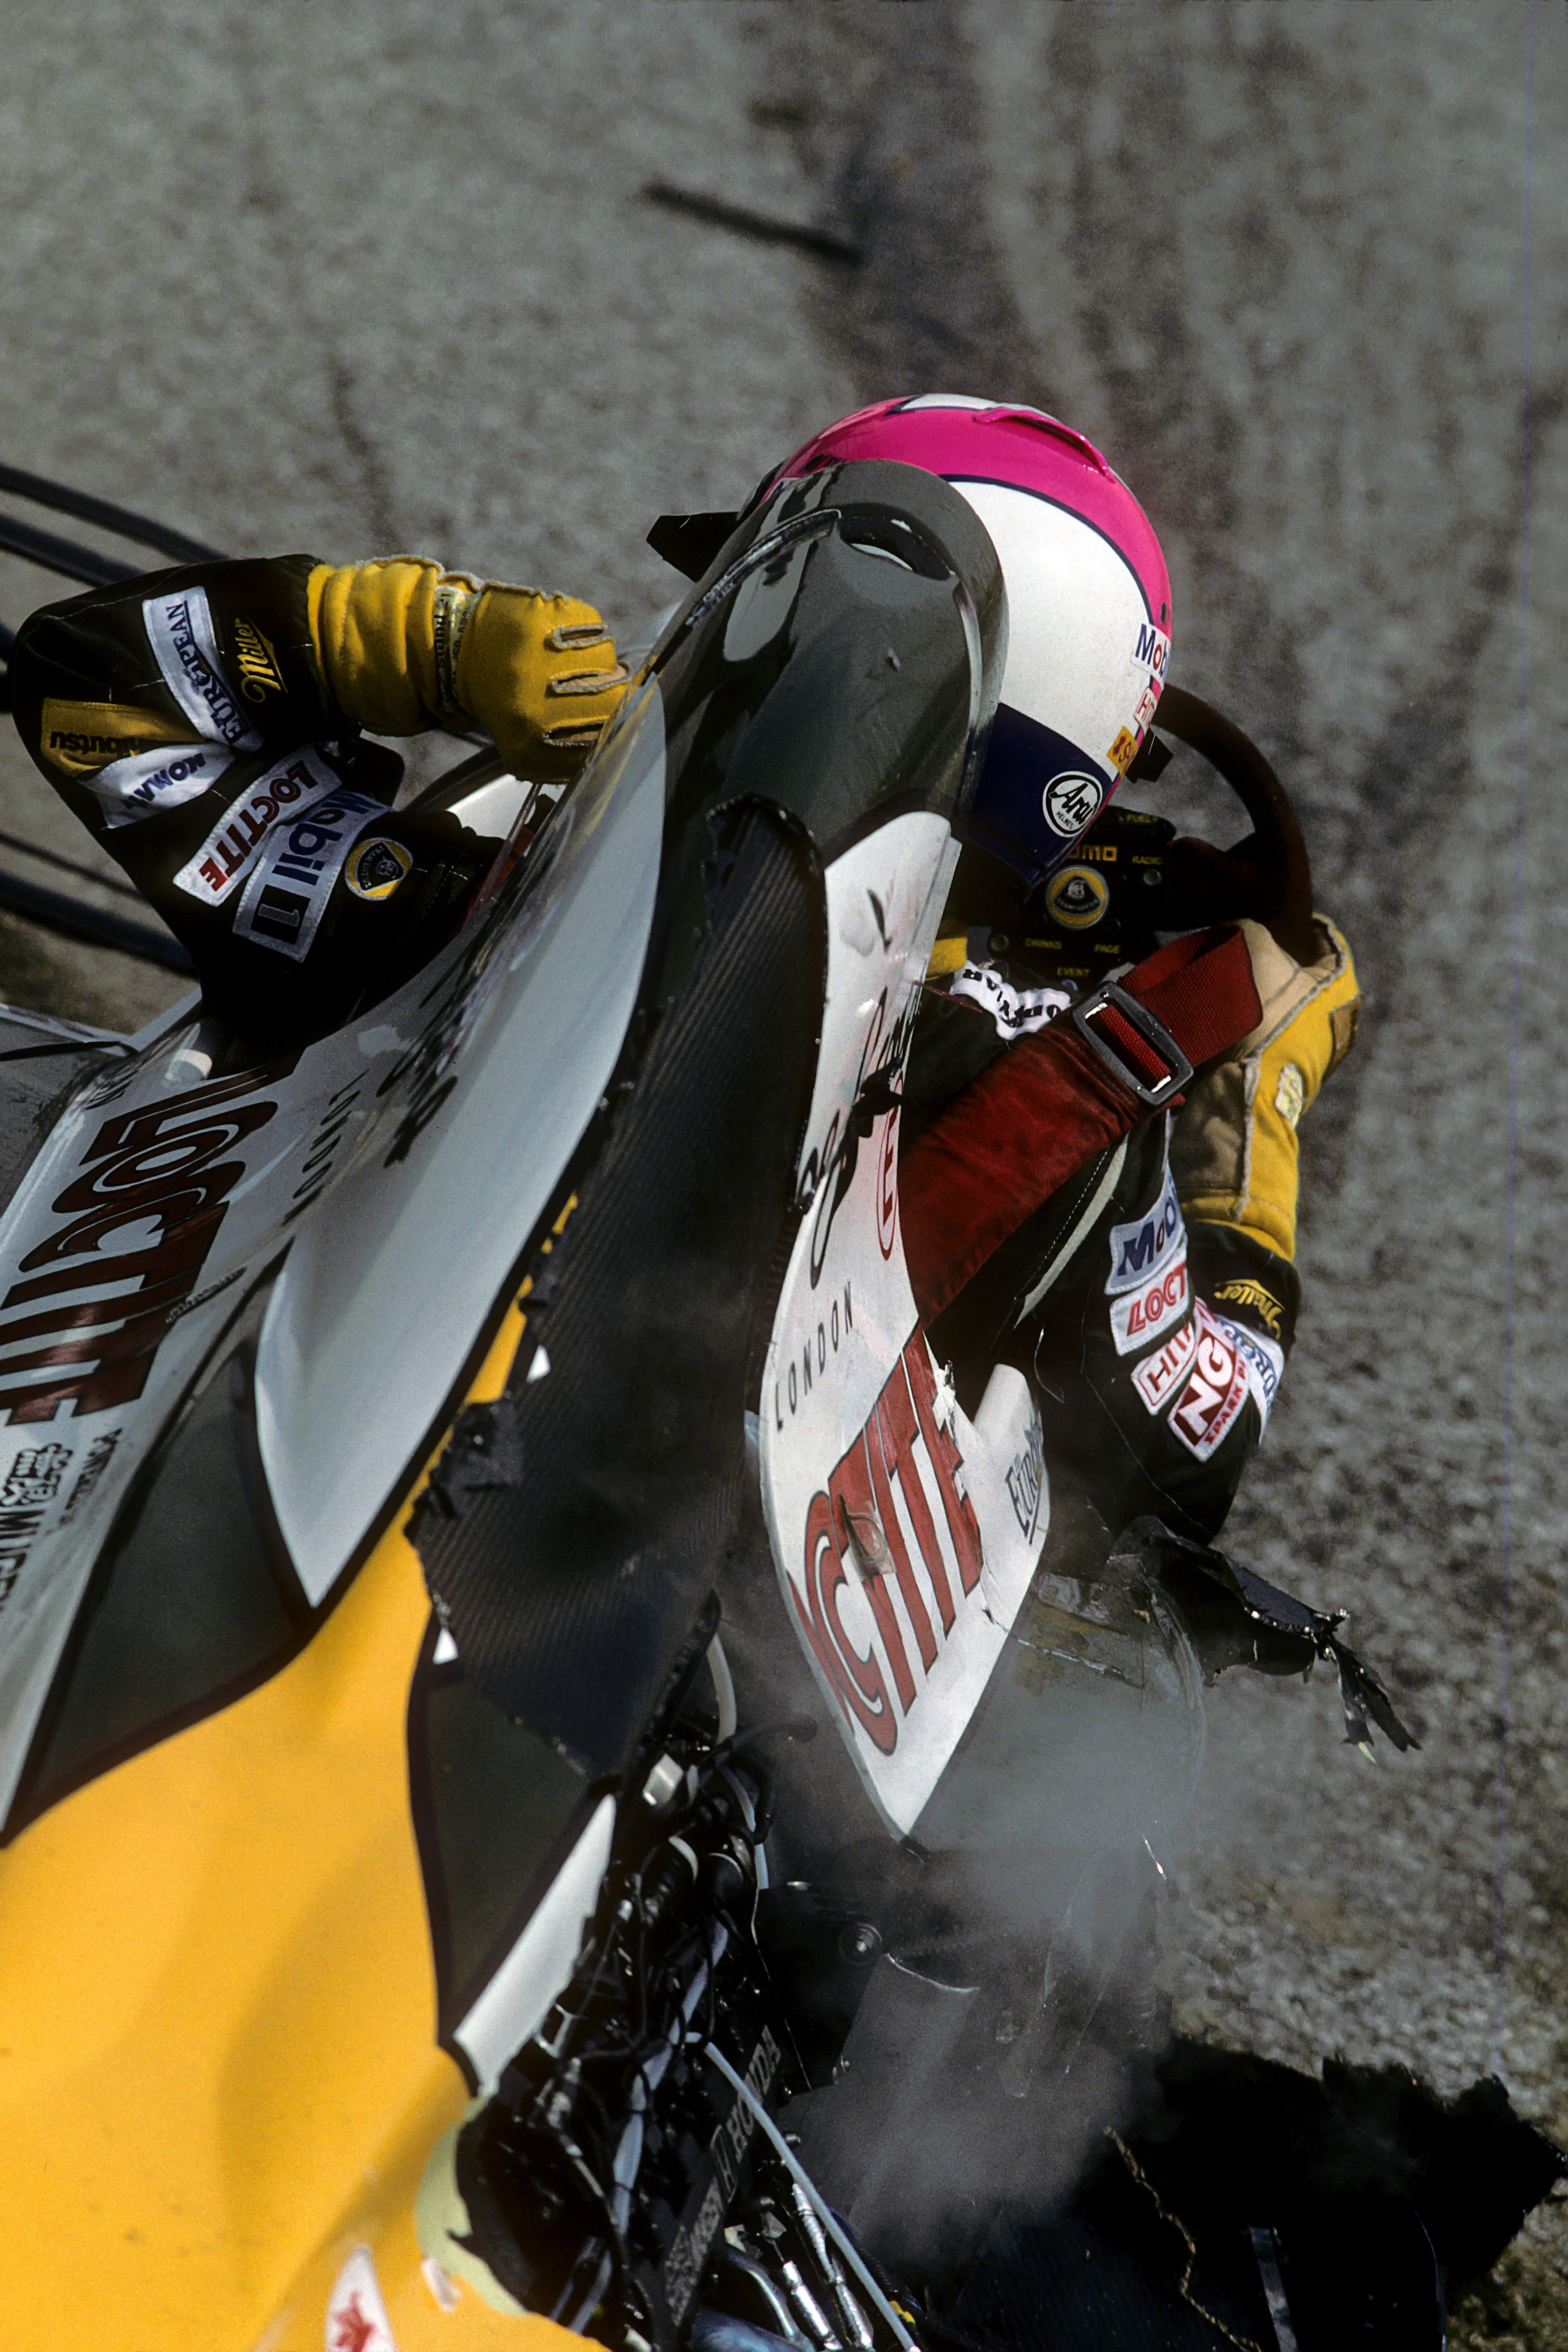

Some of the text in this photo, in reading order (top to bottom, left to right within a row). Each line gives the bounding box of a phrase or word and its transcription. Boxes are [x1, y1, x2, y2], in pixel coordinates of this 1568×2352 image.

[234, 618, 283, 703] Miller
[49, 731, 141, 757] hibutsu
[199, 759, 316, 892] LOCTITE
[272, 794, 384, 886] Mobil
[1048, 783, 1094, 824] Arai
[1127, 1261, 1187, 1336] LOCT
[1213, 1284, 1283, 1341] Miller
[775, 1280, 853, 1432] LONDON
[1203, 1386, 1244, 1446] SPARK
